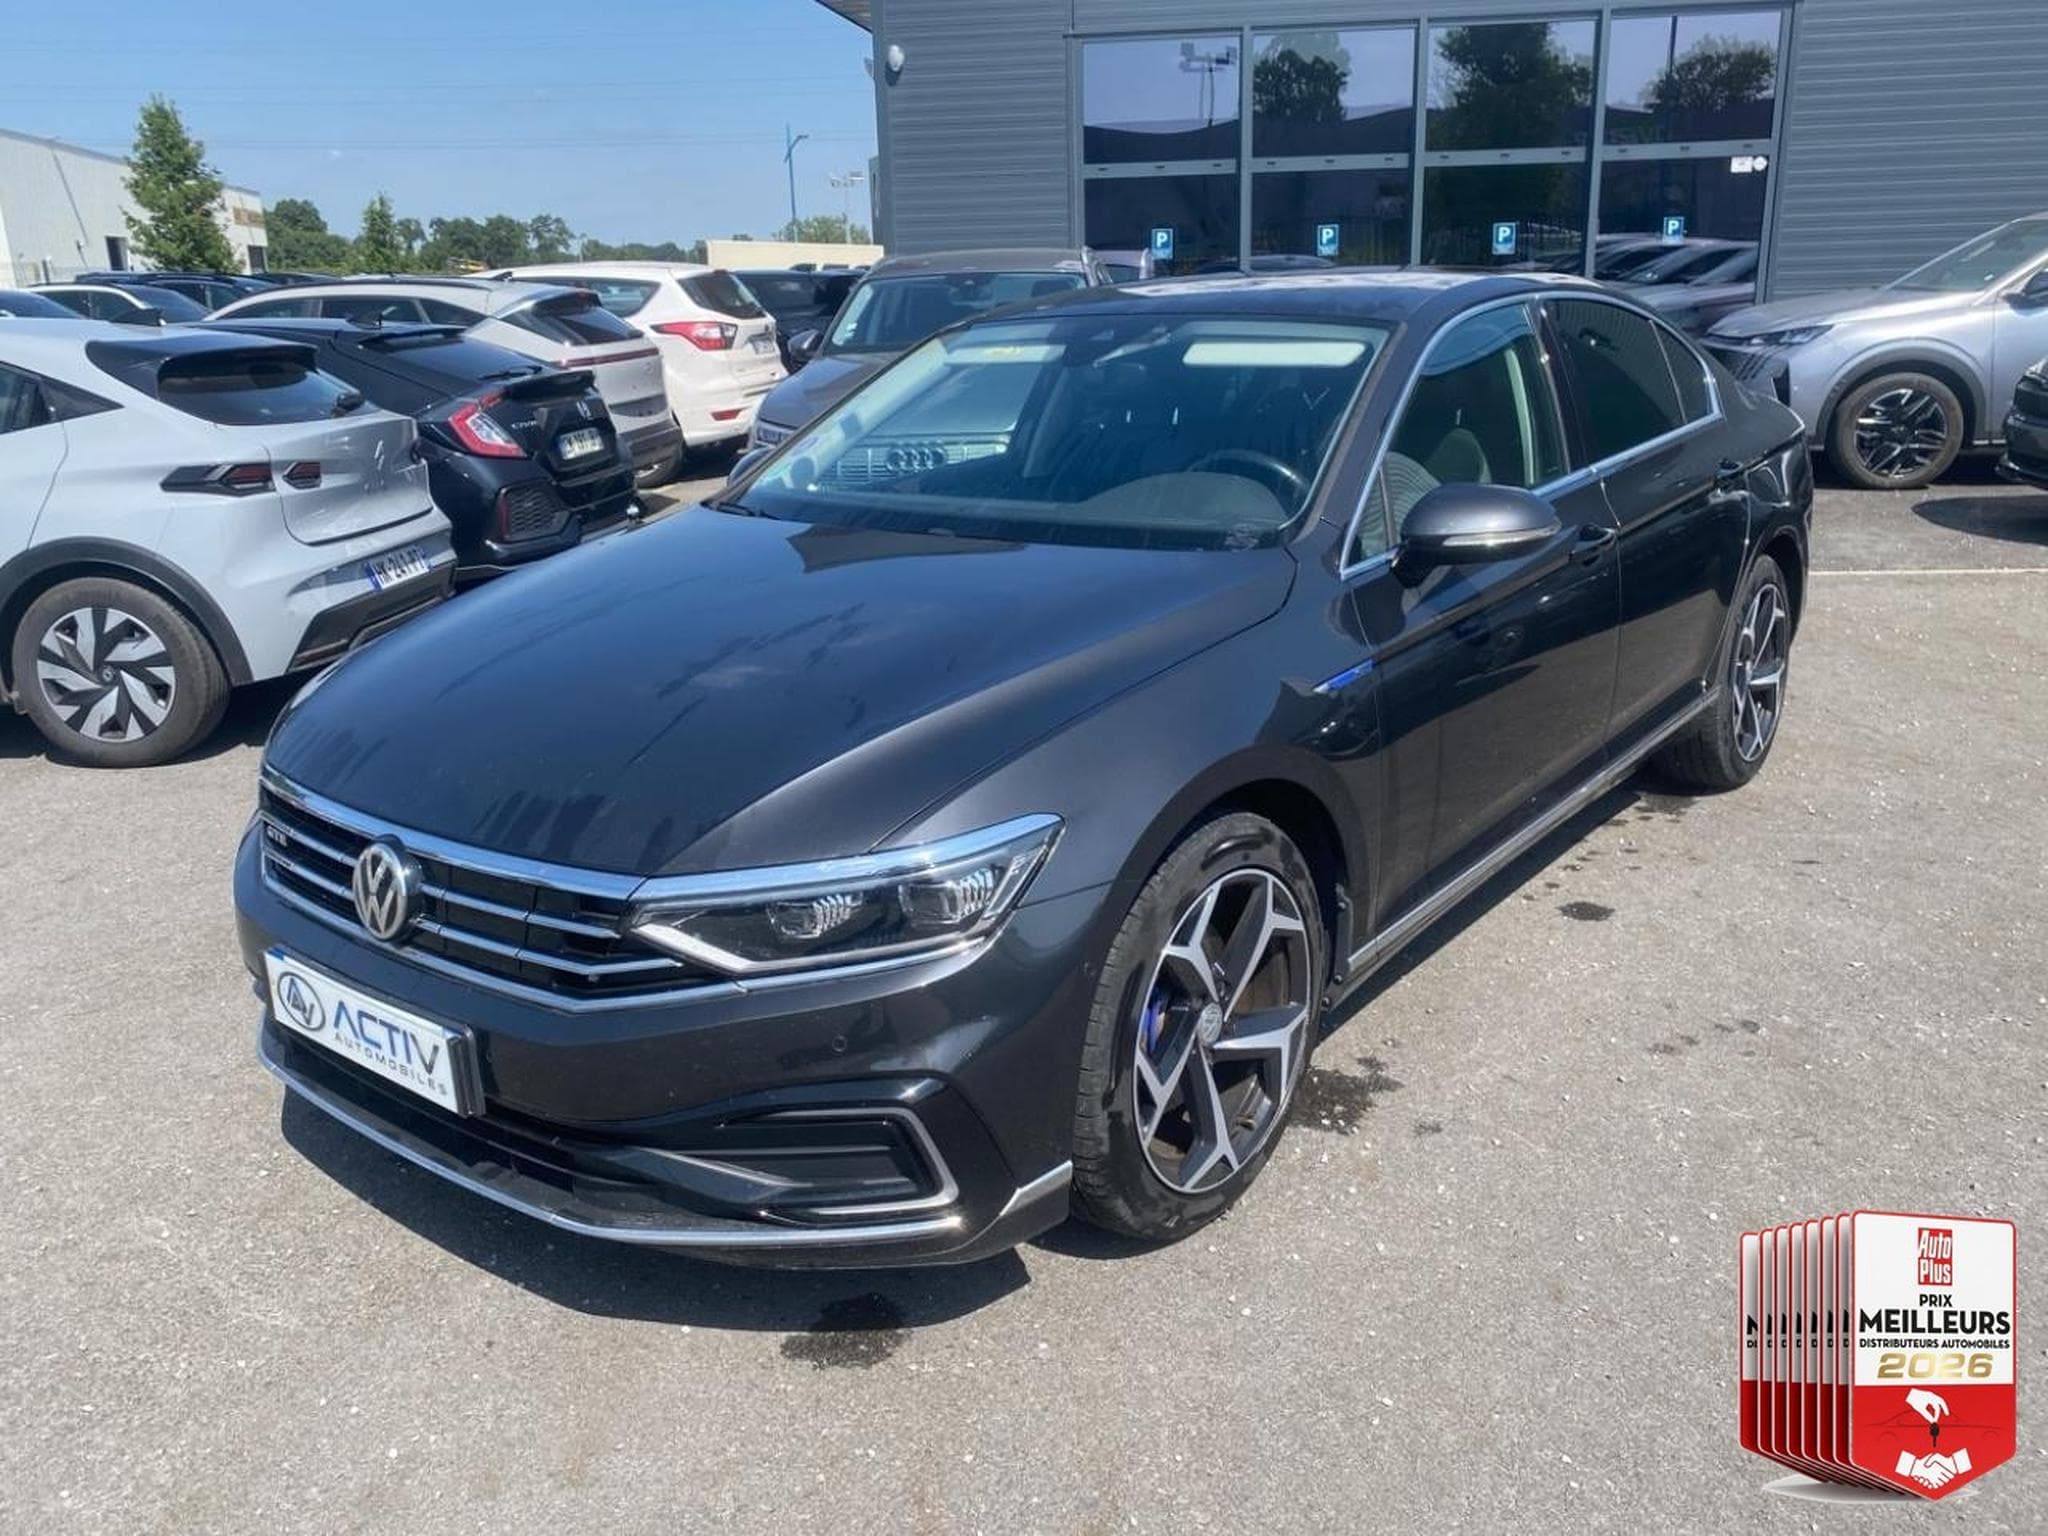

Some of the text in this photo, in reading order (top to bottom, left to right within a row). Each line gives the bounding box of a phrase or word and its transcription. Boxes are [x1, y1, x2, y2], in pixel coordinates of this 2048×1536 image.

[1322, 228, 1333, 244] P
[1498, 227, 1510, 244] P
[1667, 220, 1678, 236] P
[1156, 232, 1167, 247] P
[333, 1000, 440, 1075] ACTIV
[334, 1033, 448, 1096] AUTOMOBILES
